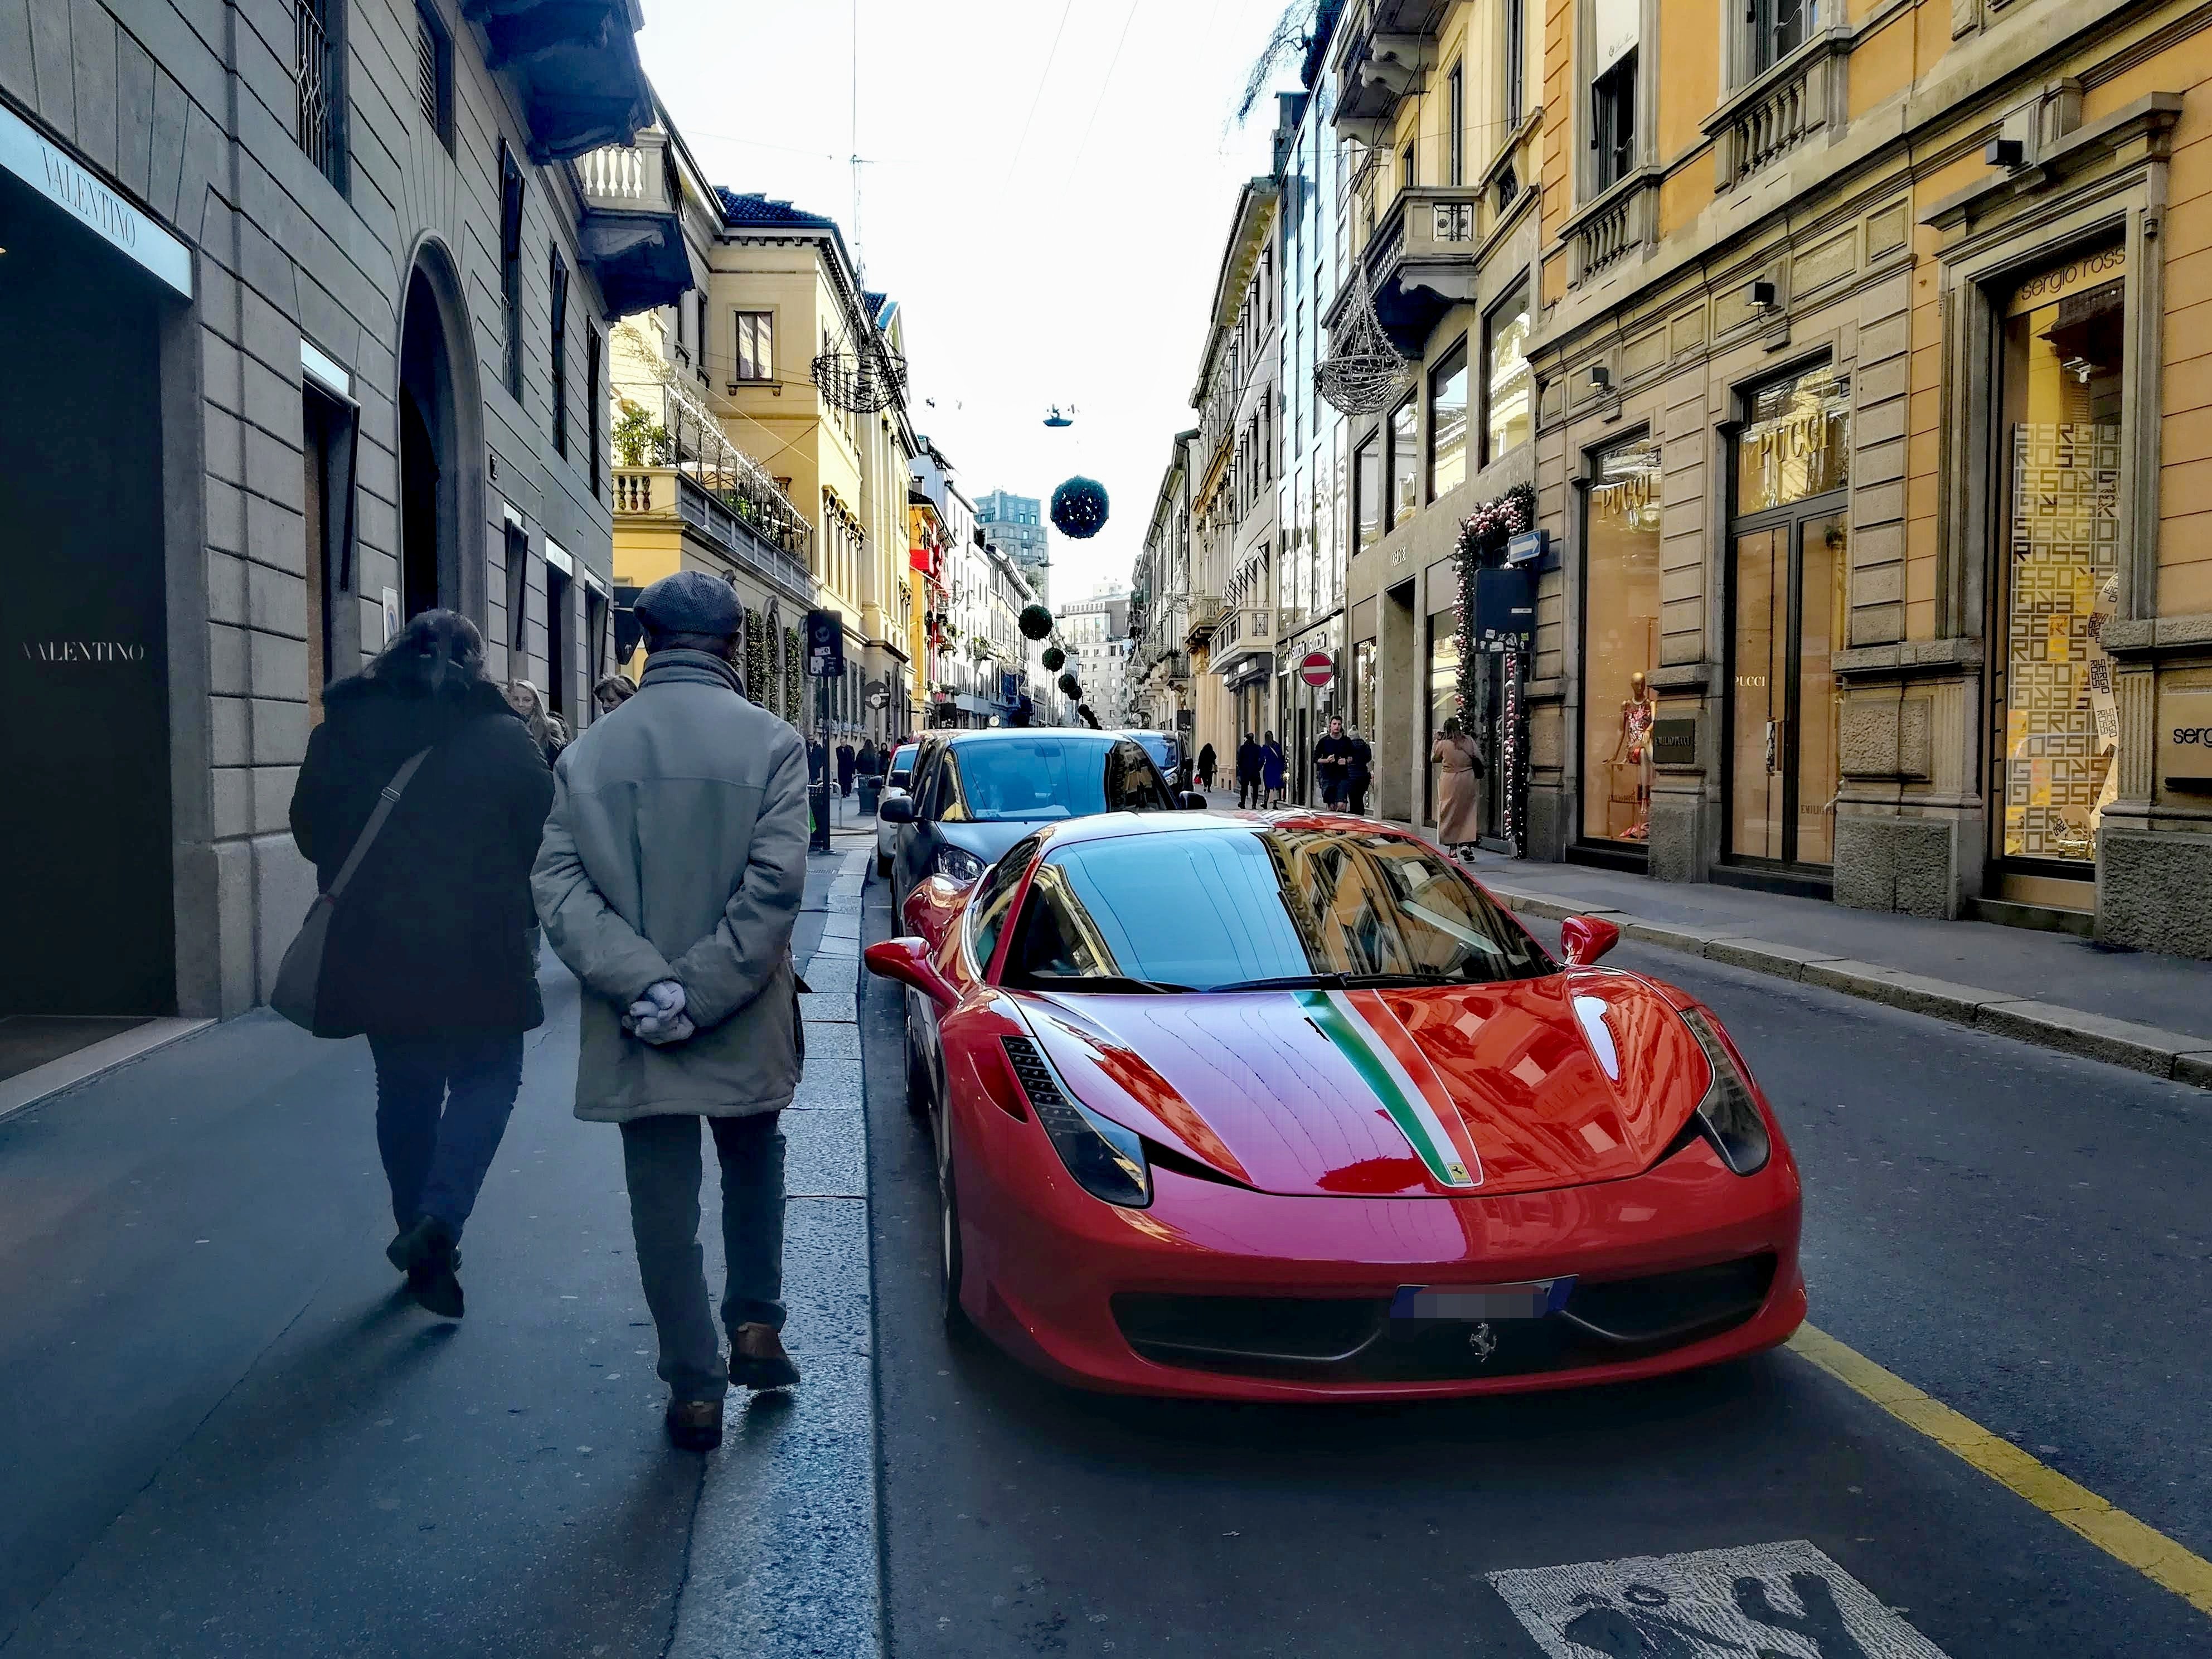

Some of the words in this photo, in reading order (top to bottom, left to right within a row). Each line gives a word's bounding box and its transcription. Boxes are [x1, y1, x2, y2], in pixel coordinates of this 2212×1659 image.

[41, 145, 135, 248] VALENTINO
[2021, 266, 2077, 300] sergio
[1755, 411, 1830, 469] PUCCI
[1601, 472, 1652, 519] PUCCI
[21, 641, 144, 662] VALENTINO
